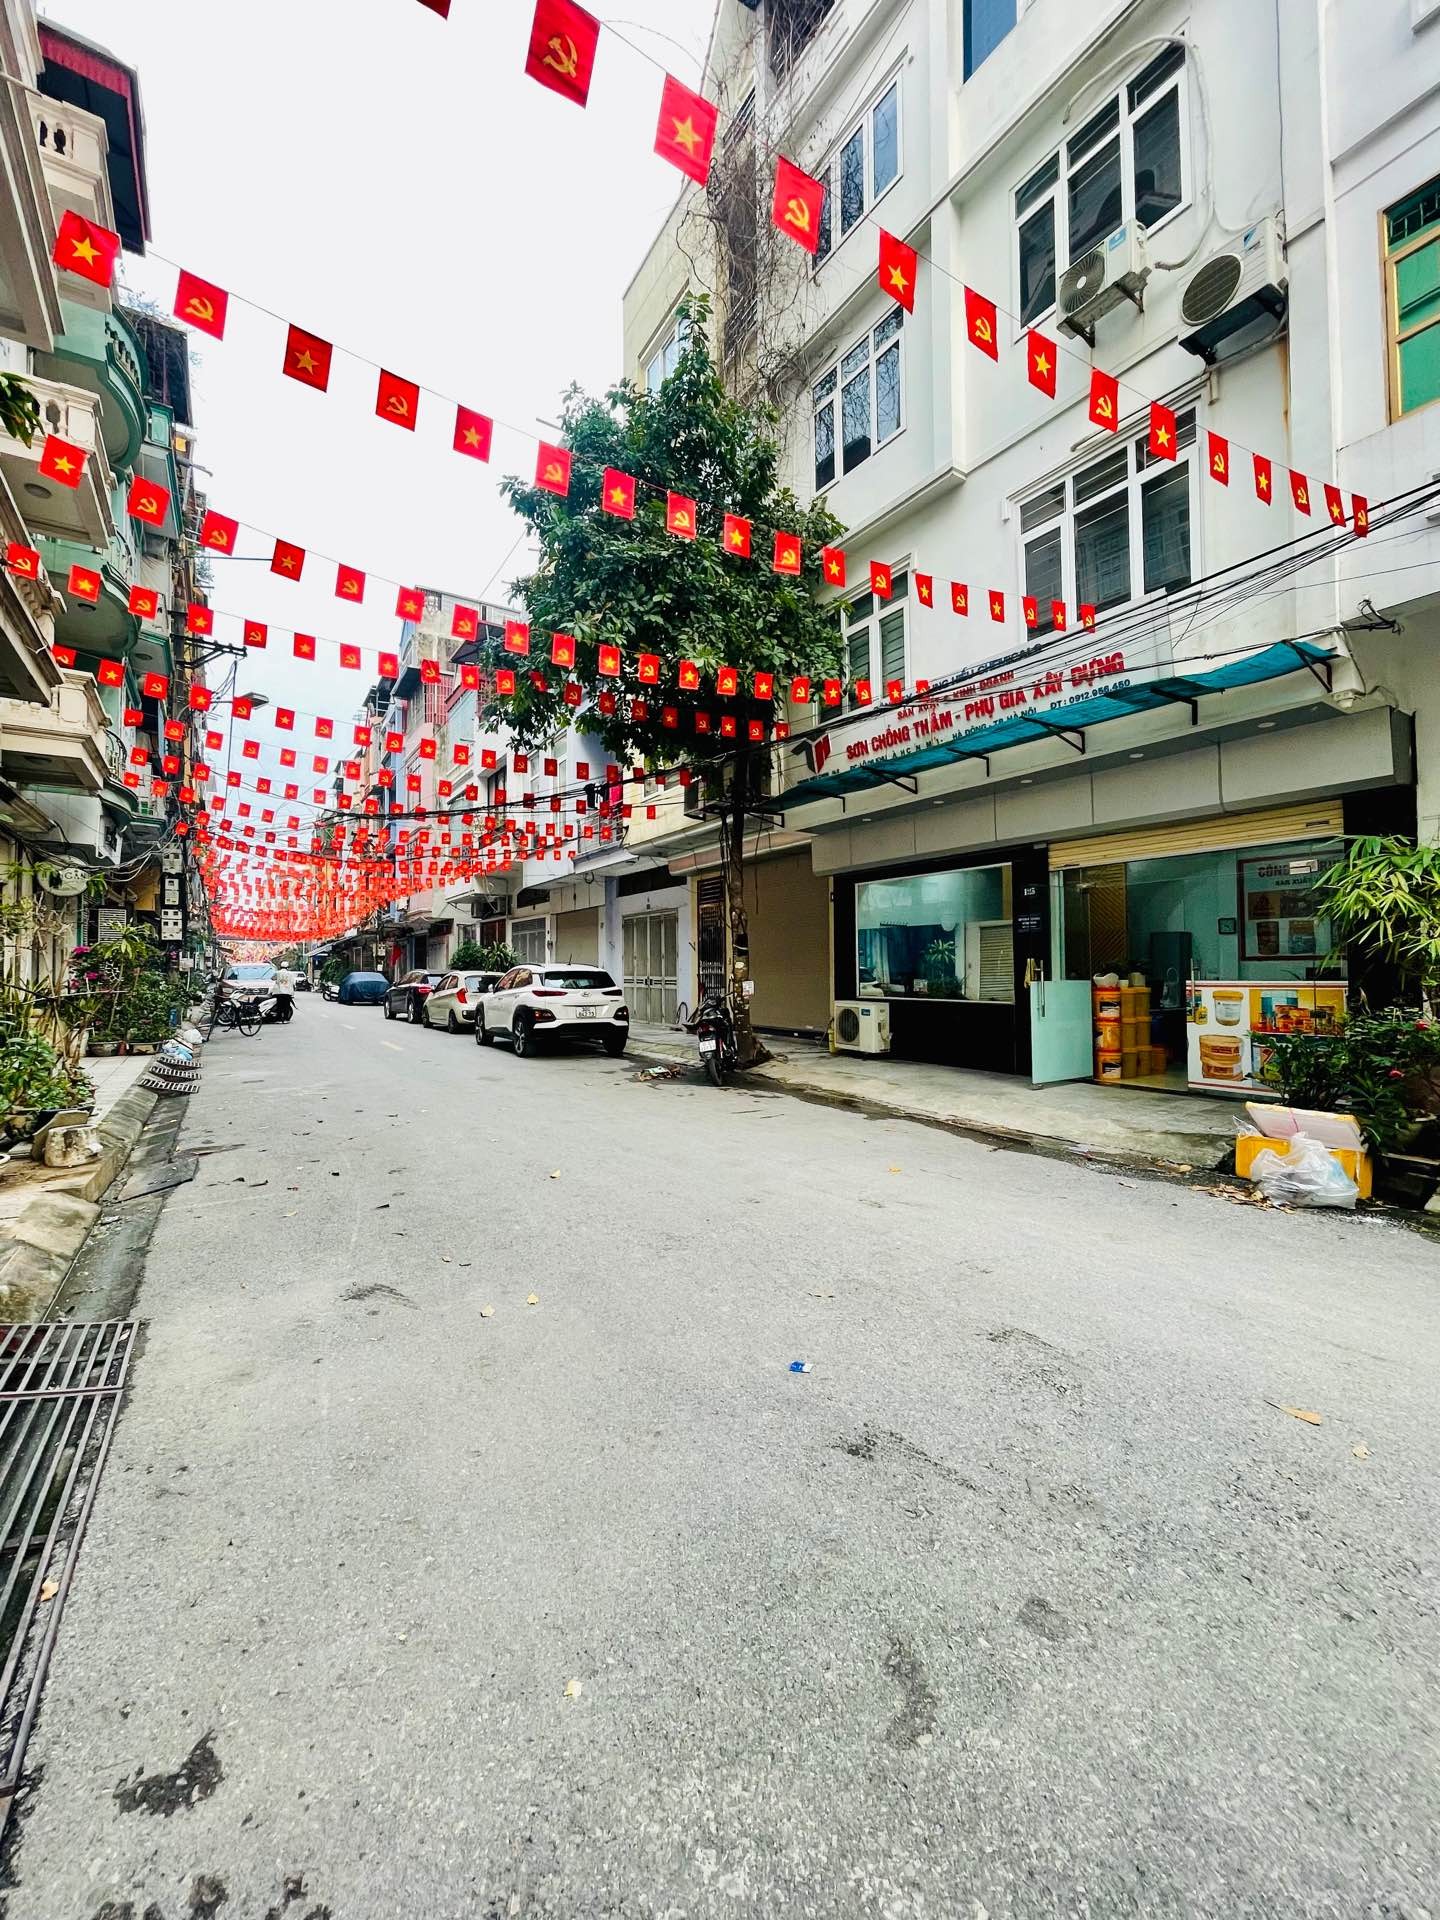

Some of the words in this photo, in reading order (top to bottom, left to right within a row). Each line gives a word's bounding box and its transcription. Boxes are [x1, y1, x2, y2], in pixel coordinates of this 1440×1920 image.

[846, 740, 869, 761] SƠN
[872, 724, 910, 752] CHỐNG
[913, 709, 953, 740] THẤM
[965, 696, 995, 721] PHỤ
[999, 690, 1027, 711] GIA
[1032, 671, 1064, 700] XÂY
[1070, 651, 1125, 688] DỰNG
